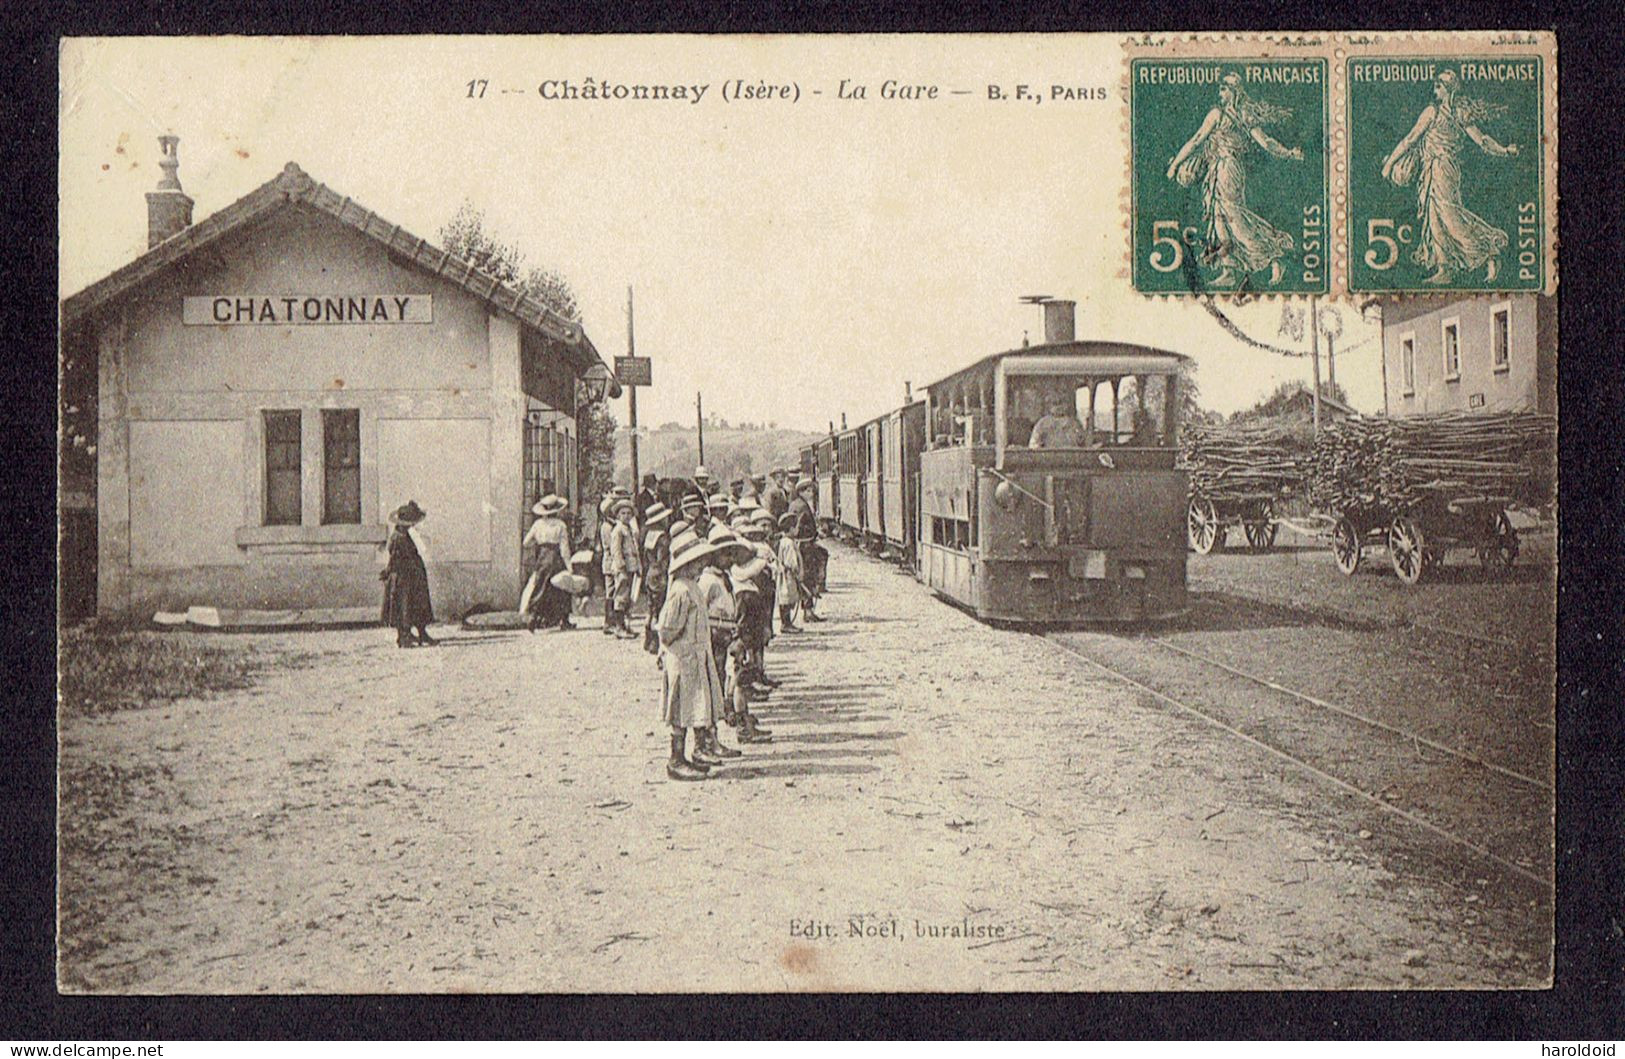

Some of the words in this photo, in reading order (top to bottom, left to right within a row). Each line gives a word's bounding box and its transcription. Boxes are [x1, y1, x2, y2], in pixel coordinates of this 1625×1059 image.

[1246, 66, 1320, 85] FRANÇAISE
[1460, 63, 1535, 83] FRANÇAISE
[1303, 204, 1321, 283] POSTES
[1519, 201, 1536, 280] POSTES
[212, 296, 411, 322] CHATONNAY
